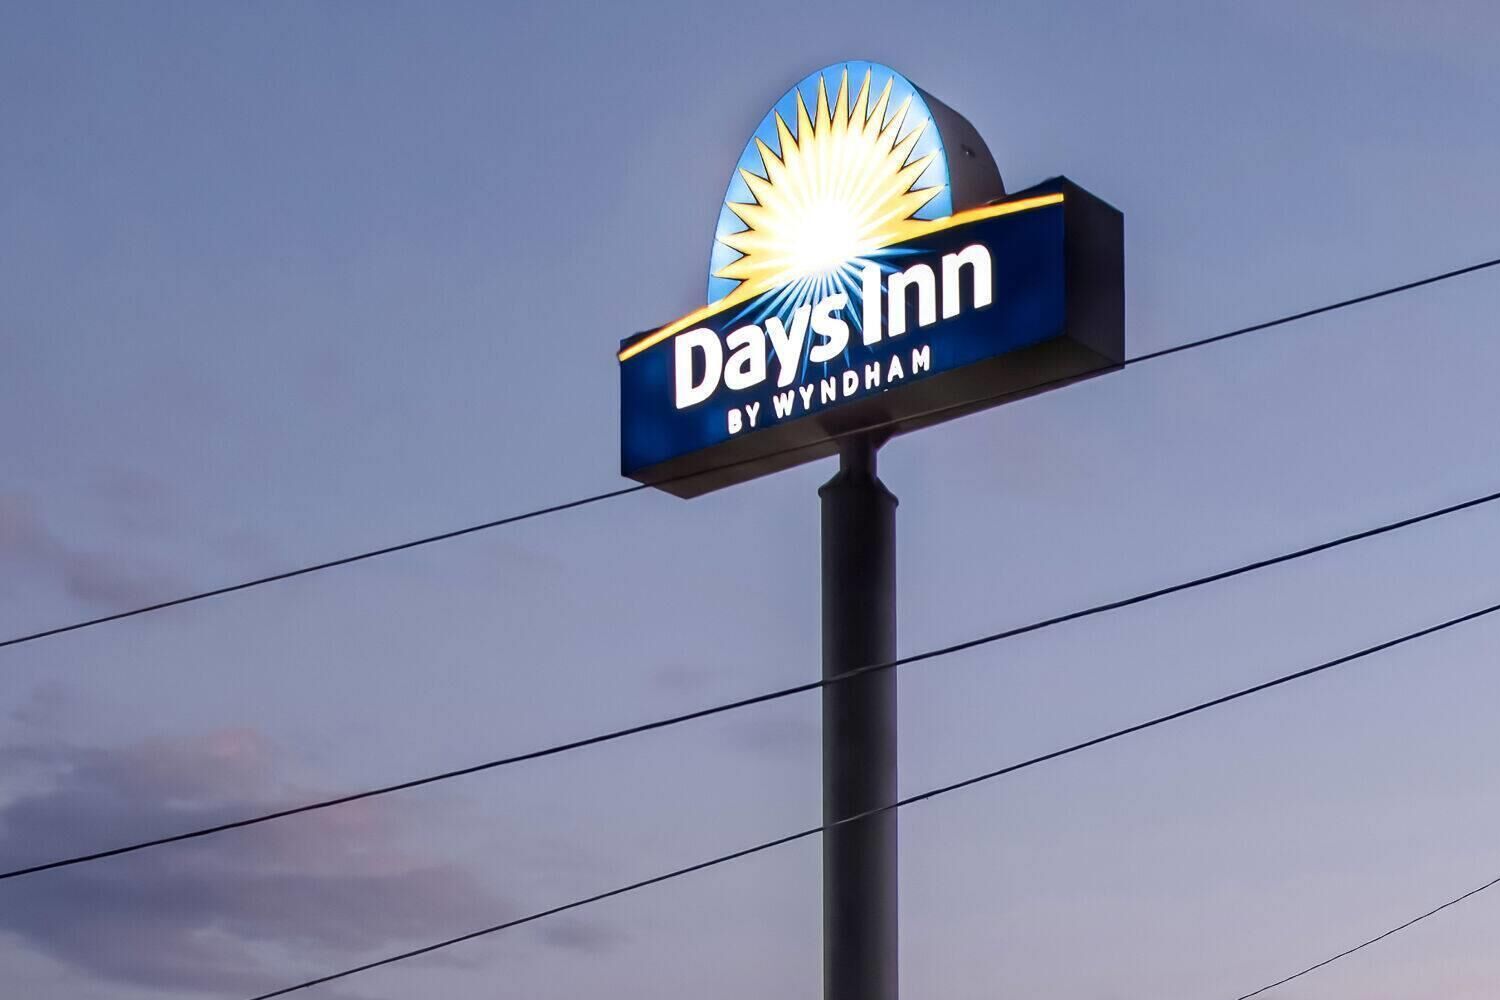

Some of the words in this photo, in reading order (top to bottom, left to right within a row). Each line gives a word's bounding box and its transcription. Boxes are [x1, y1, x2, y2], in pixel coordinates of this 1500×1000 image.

[674, 291, 850, 409] Days
[861, 243, 992, 346] Inn
[727, 401, 760, 434] BY
[772, 345, 931, 419] WYNDHAM
